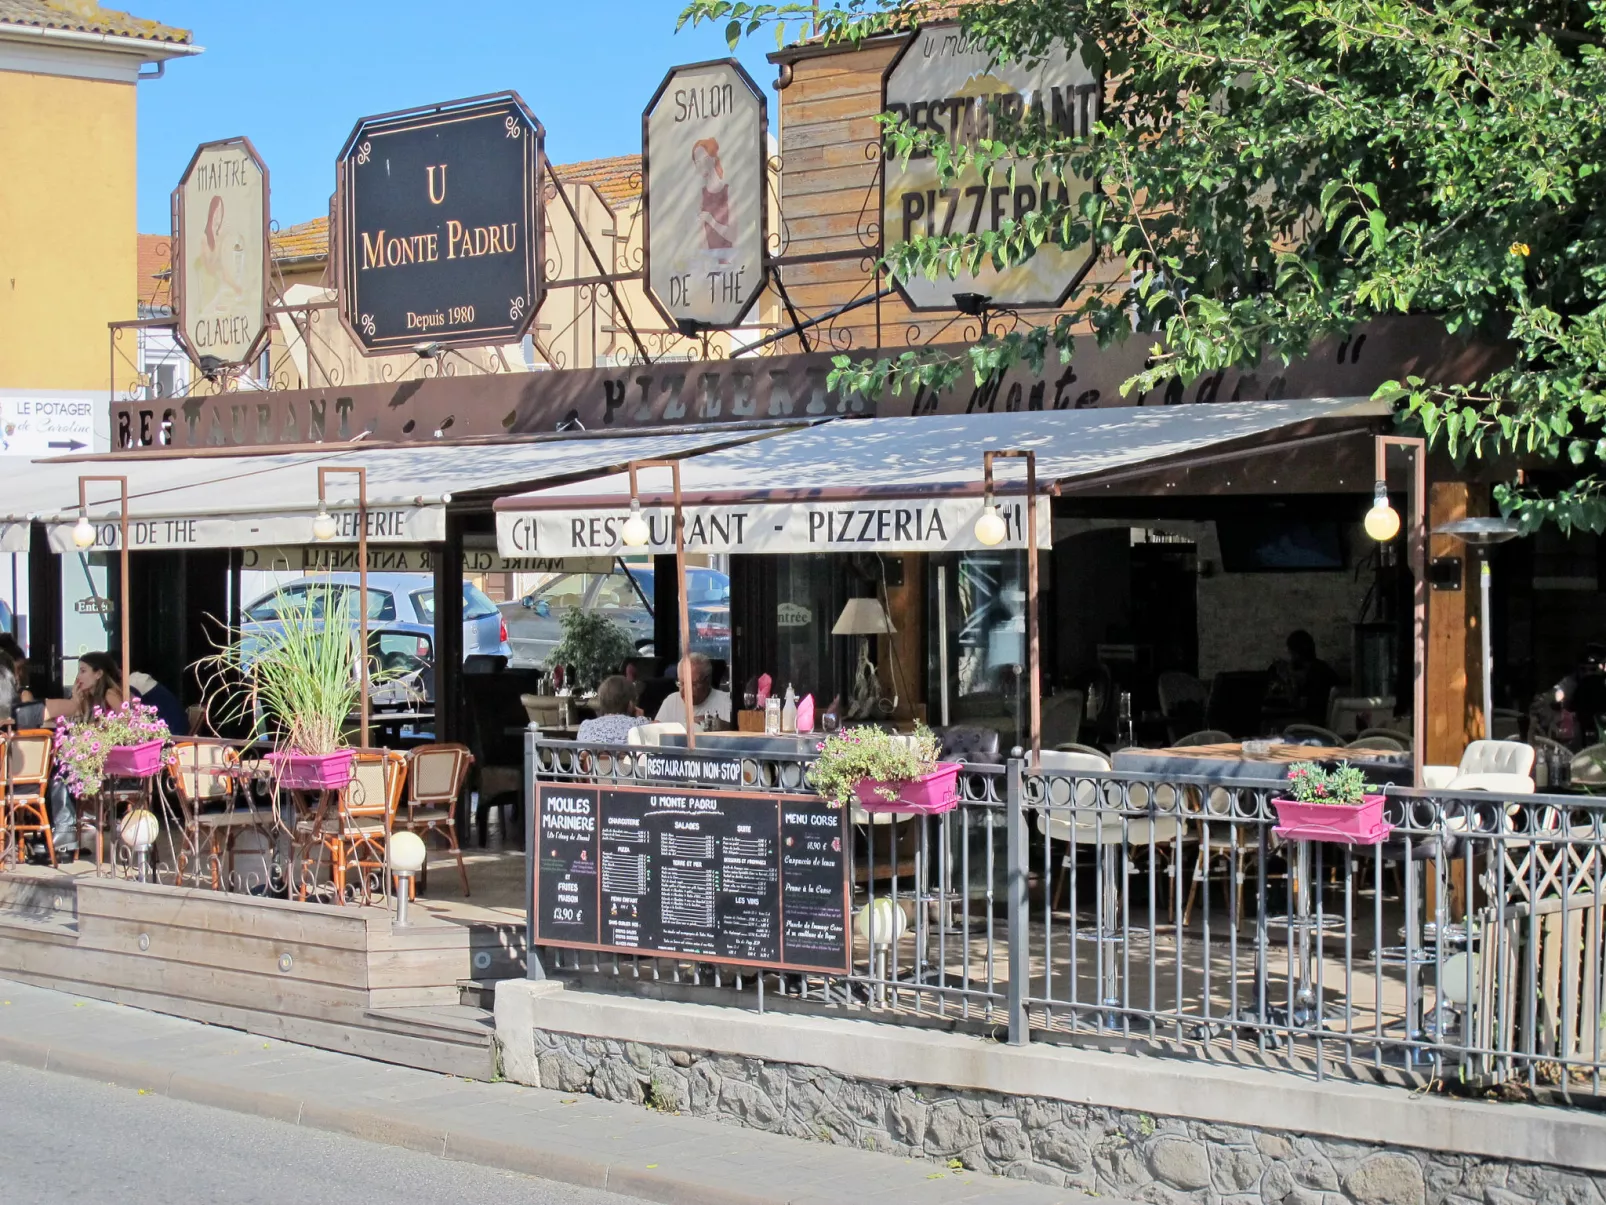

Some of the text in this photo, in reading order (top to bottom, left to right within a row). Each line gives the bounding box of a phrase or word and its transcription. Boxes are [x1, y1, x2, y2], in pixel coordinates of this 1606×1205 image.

[674, 83, 733, 123] SALON
[426, 164, 448, 205] U
[901, 181, 1073, 245] PIZZERIA
[670, 264, 746, 308] DE THÉ
[407, 305, 475, 331] Depuis 1980
[195, 314, 251, 348] GLACIER
[17, 402, 92, 417] LE POTAGER
[17, 417, 91, 434] de Caroline
[117, 396, 355, 449] RESTAURANT
[136, 521, 157, 545] DE
[164, 519, 197, 543] THE
[330, 510, 405, 537] REPERIE
[571, 513, 748, 548] RESTURANT
[809, 507, 948, 543] PIZZERIA
[778, 611, 809, 623] ntrée
[647, 758, 741, 781] RESTAURATION NON-STOP
[547, 797, 590, 814] MOULES
[650, 796, 717, 810] U MONTE PADRU
[542, 814, 595, 831] MARINIERE
[785, 813, 838, 827] MENU CORSE
[812, 856, 821, 866] de
[557, 882, 579, 892] FRITES
[557, 894, 579, 904] MAISON
[735, 897, 745, 905] LES
[553, 908, 583, 921] 13,90 €
